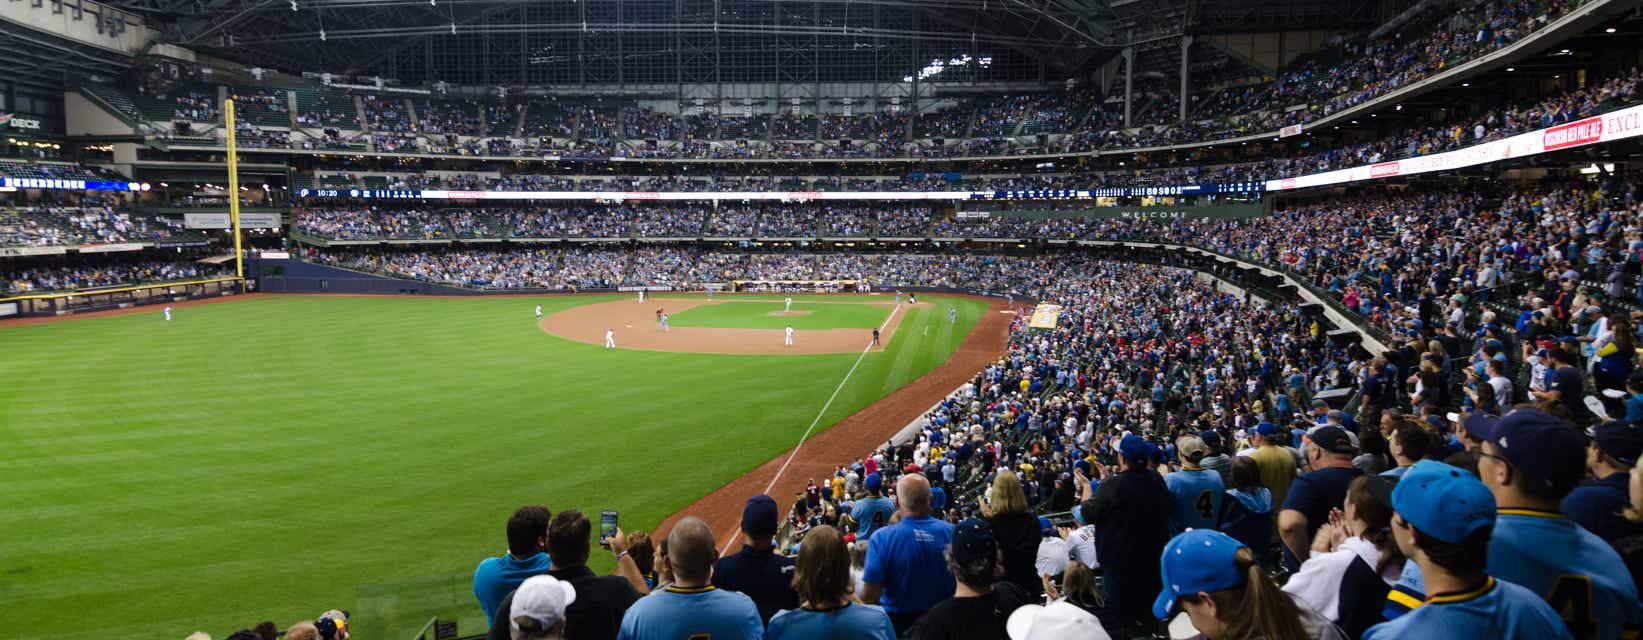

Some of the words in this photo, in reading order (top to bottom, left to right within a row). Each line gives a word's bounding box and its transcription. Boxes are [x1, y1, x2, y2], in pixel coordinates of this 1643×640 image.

[10, 118, 41, 129] DECK
[317, 189, 338, 197] 10:20
[1121, 211, 1186, 219] WELCOME
[1195, 489, 1214, 519] 4
